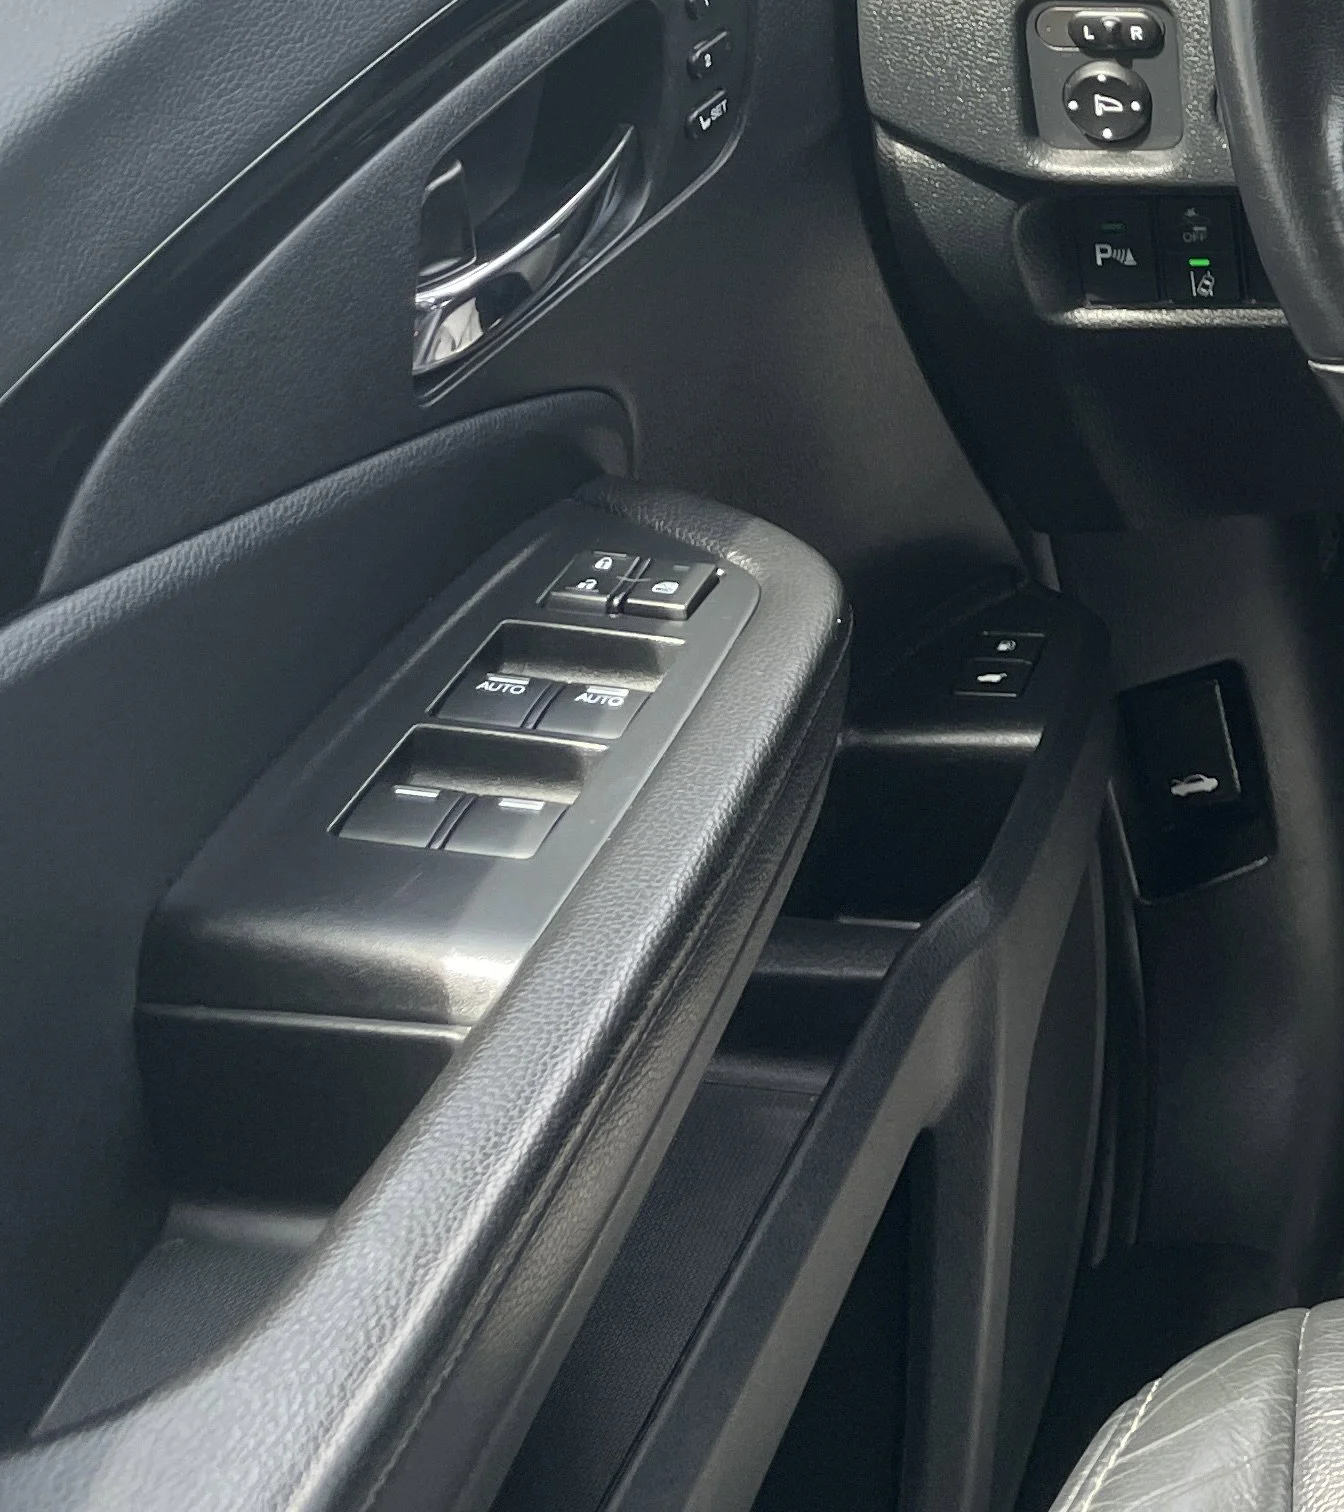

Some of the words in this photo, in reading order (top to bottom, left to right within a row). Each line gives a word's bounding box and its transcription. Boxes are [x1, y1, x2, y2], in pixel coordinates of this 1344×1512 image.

[1082, 24, 1095, 40] L
[1130, 25, 1144, 40] R
[710, 98, 728, 121] SET
[475, 680, 526, 695] AUTO
[574, 692, 625, 707] AUTO
